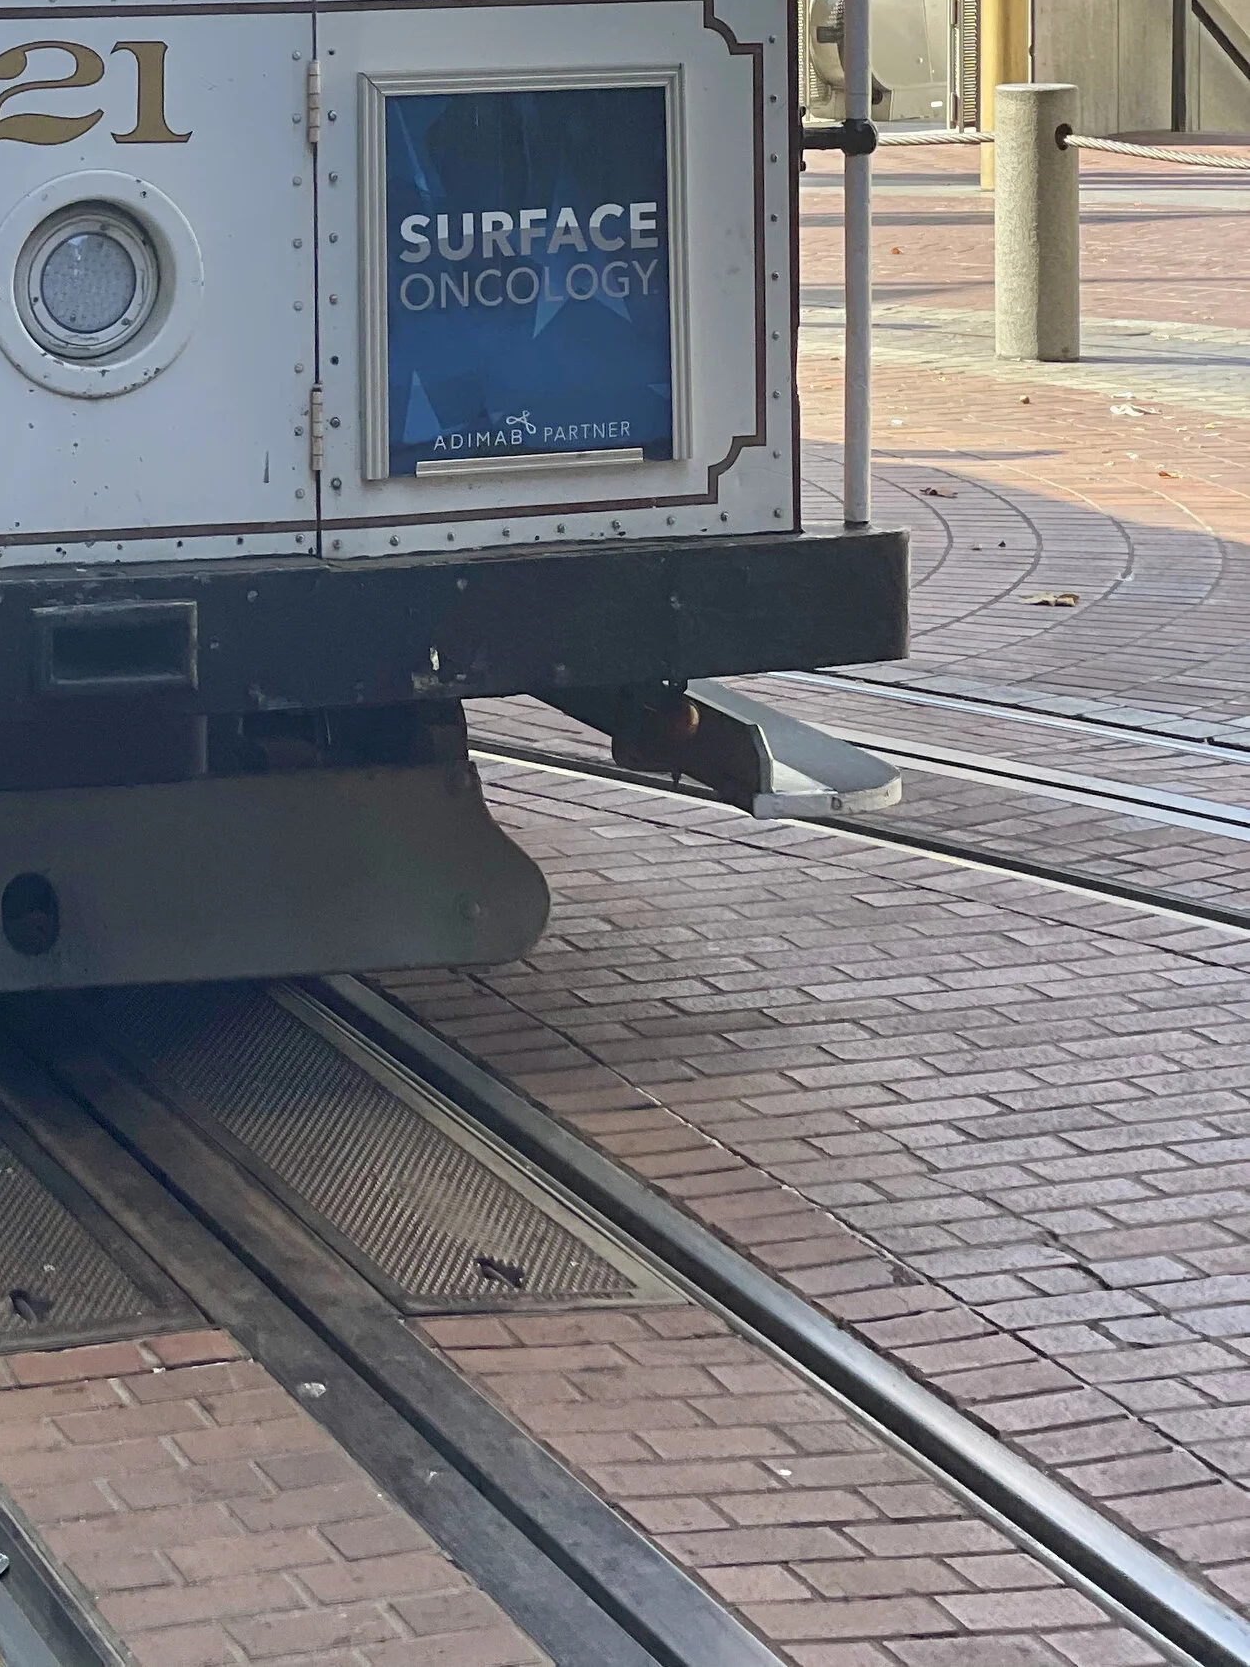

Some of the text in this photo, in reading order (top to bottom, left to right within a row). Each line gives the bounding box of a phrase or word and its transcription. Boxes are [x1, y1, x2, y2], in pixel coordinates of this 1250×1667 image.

[398, 201, 659, 264] SURFACE
[399, 258, 659, 312] ONCOLOGY
[433, 420, 632, 451] ADIMAB PARTNER
